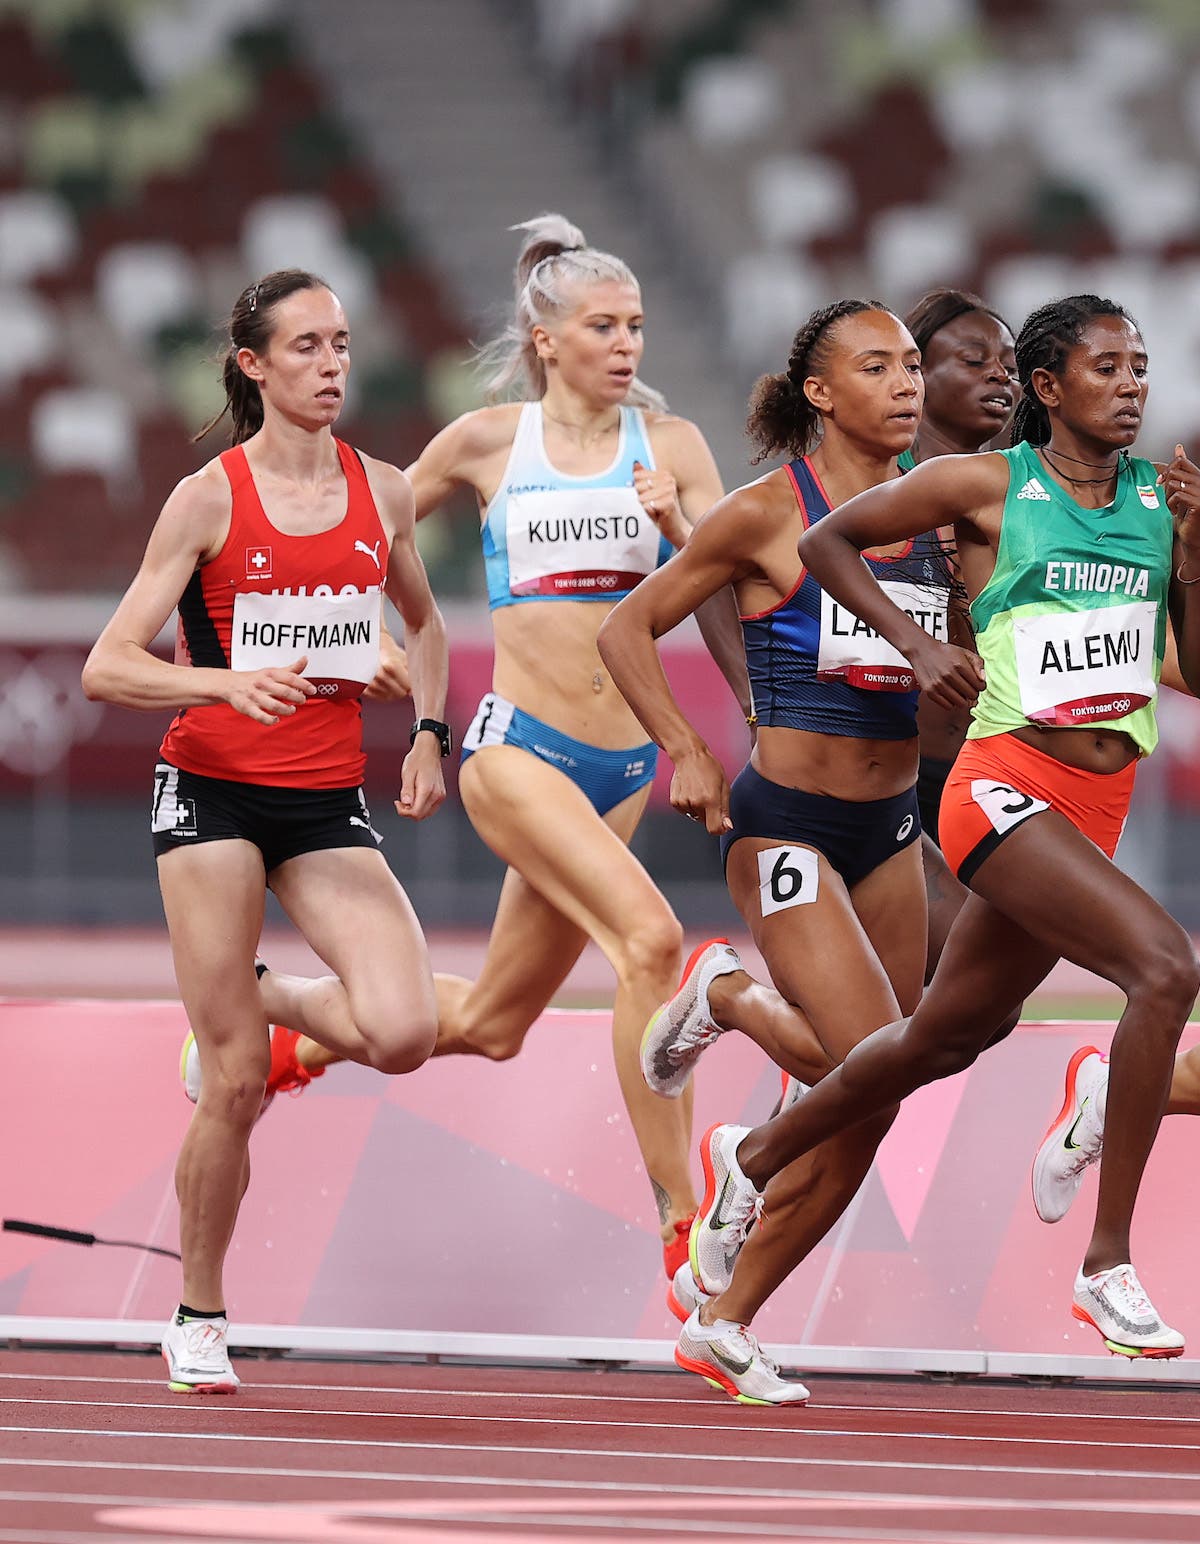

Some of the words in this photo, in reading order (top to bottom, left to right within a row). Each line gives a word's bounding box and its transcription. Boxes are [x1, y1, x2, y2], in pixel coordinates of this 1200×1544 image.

[1017, 491, 1051, 502] adidas
[528, 516, 640, 543] KUIVISTO
[554, 579, 577, 588] TOKYO
[578, 578, 596, 587] 2020
[1044, 561, 1149, 597] ETHIOPIA
[241, 620, 371, 648] HOFFMANN
[1040, 629, 1140, 674] ALEMU
[863, 673, 885, 683] TOKYO
[885, 674, 899, 684] 2020
[1071, 706, 1096, 716] TOKYO
[1095, 703, 1113, 713] 2020
[154, 771, 169, 825] 7
[770, 851, 803, 903] 6
